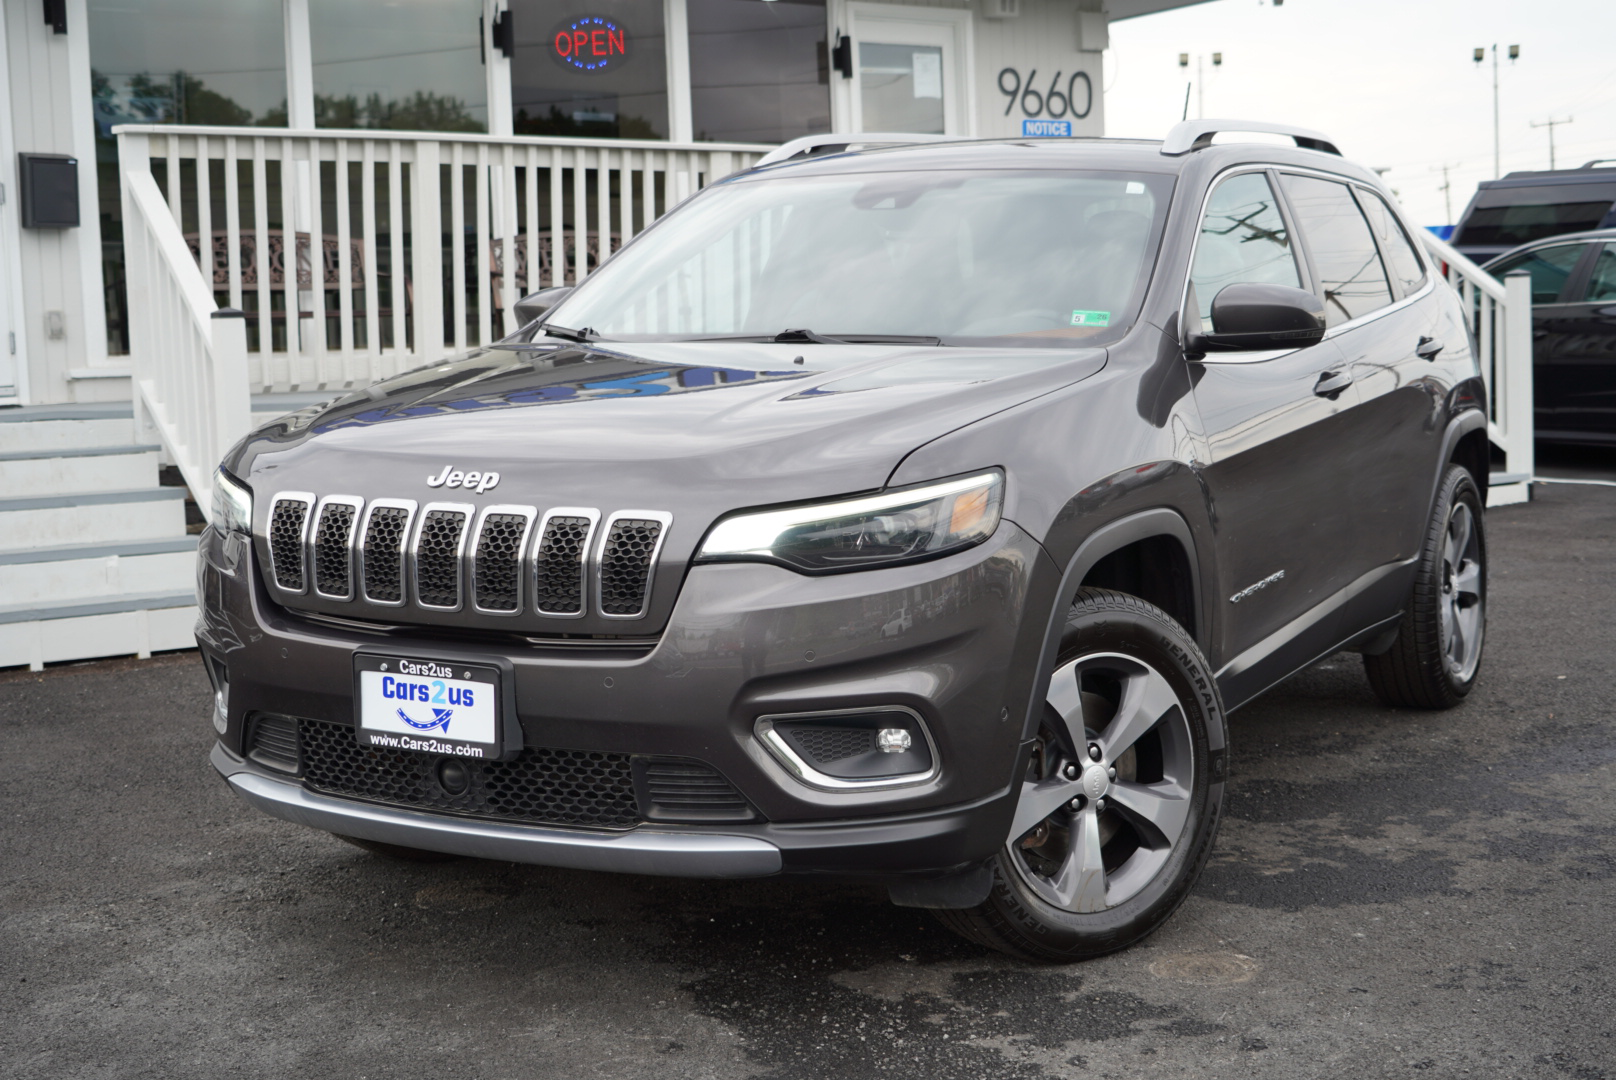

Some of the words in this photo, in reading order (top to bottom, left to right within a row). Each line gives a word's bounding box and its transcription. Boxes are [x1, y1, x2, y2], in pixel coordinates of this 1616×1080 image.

[555, 29, 625, 57] OPEN
[997, 67, 1092, 120] 9660
[1026, 121, 1068, 136] NOTICE
[426, 465, 501, 495] Jeep
[399, 660, 453, 678] Cars2us
[1160, 636, 1217, 721] GENERAL
[382, 676, 475, 707] Cars2us
[370, 734, 483, 758] www.Cars2us.com
[994, 858, 1050, 936] GENERA
